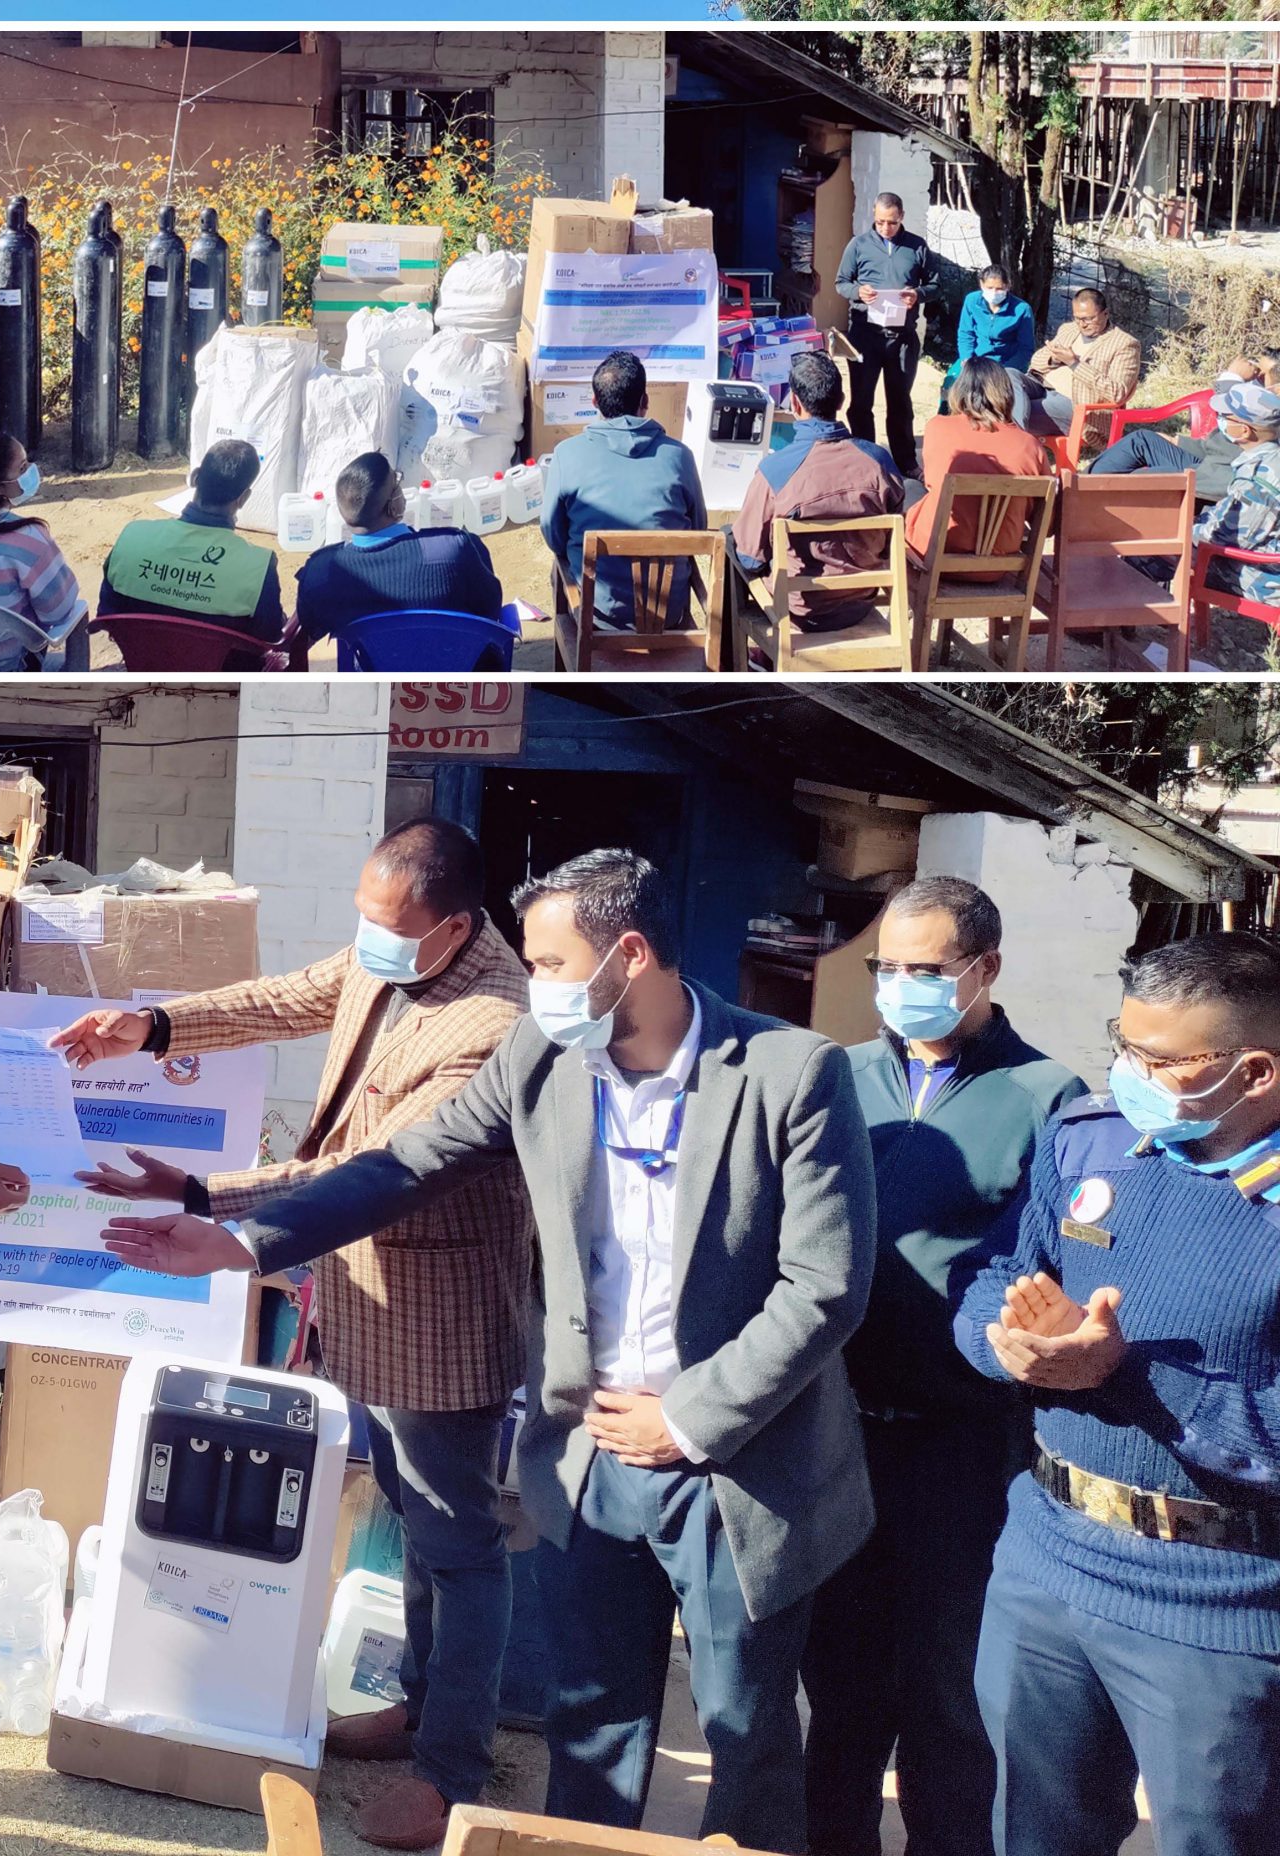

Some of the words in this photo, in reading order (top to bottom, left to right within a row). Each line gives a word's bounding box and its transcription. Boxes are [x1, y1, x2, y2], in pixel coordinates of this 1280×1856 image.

[556, 269, 575, 278] KOICA
[431, 388, 451, 397] KOICA
[546, 391, 566, 400] KOICA
[138, 558, 215, 588] 굿네이버스
[150, 584, 171, 596] Good
[173, 588, 212, 603] Neighbors
[389, 682, 512, 714] SSD
[95, 1079, 127, 1092] सहयोगी
[75, 1103, 131, 1120] Vulnerable
[133, 1108, 203, 1126] Communities
[204, 1113, 216, 1127] in
[29, 1192, 81, 1210] ospital,
[85, 1194, 132, 1214] Bajura
[11, 1212, 46, 1228] 2021
[3, 1248, 27, 1263] with
[29, 1249, 48, 1263] the
[49, 1251, 86, 1271] People
[86, 1254, 100, 1270] of
[150, 1324, 185, 1335] PeaceWin
[31, 1352, 131, 1371] CONCENTRATO
[157, 1561, 187, 1580] KOICA
[249, 1580, 287, 1596] owgels
[364, 1636, 383, 1648] KOICA
